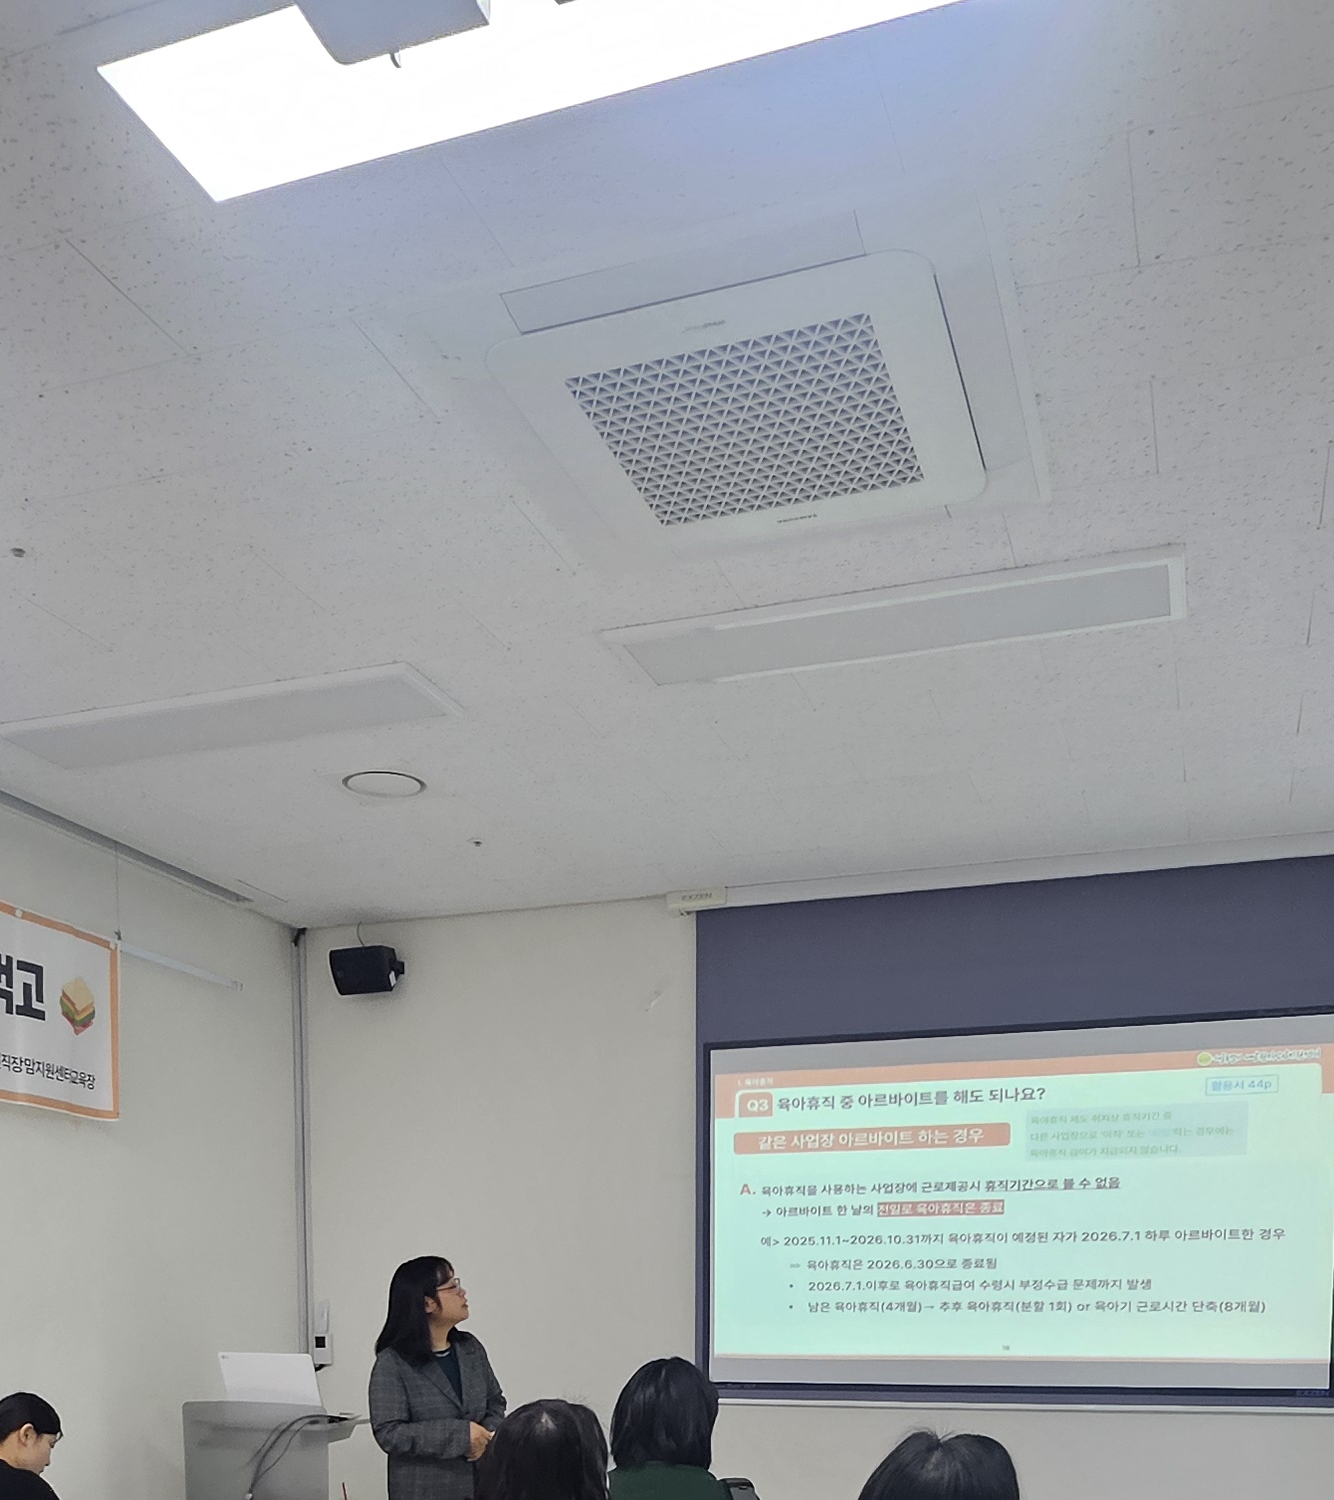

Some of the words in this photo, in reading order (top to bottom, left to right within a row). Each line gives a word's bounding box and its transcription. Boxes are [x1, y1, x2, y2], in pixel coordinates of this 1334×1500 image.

[1248, 1080, 1272, 1091] 44p
[747, 1099, 769, 1113] Q3
[777, 1095, 836, 1112] 육아휴직
[840, 1095, 854, 1110] 중
[858, 1090, 949, 1109] 아르바이트를
[953, 1089, 984, 1105] 해도
[988, 1087, 1046, 1104] 되나요?
[758, 1135, 787, 1151] 같은
[791, 1133, 835, 1150] 사업장
[838, 1130, 914, 1148] 아르바이트
[918, 1129, 949, 1145] 하는
[953, 1127, 984, 1144] 경우
[761, 1185, 818, 1197] 육아휴직을
[820, 1183, 868, 1196] 사용하는
[870, 1181, 918, 1195] 사업장에
[921, 1180, 981, 1194] 근로제공시
[985, 1178, 1059, 1193] 휴직기간으로
[1078, 1177, 1092, 1190] 수
[1095, 1176, 1121, 1190] 없음
[776, 1204, 833, 1218] 아르바이트
[837, 1204, 848, 1217] 한
[916, 1201, 977, 1215] 육아휴직은
[784, 1233, 944, 1247] 2025.11.1~2026.10.31까지
[948, 1232, 1008, 1245] 육아휴직이
[1012, 1231, 1049, 1244] 예정된
[1052, 1230, 1078, 1243] 자가
[1081, 1231, 1141, 1243] 2026.7.1
[1144, 1229, 1171, 1242] 하루
[1174, 1228, 1254, 1242] 아르바이트한
[1259, 1227, 1286, 1240] 경우
[807, 1259, 864, 1271] 육아휴직은
[867, 1259, 958, 1270] 2026.6.30으로
[904, 1279, 976, 1292] 육아휴직급여
[979, 1279, 1015, 1291] 수령시
[1019, 1278, 1069, 1291] 부정수급
[1072, 1278, 1122, 1291] 문제까지
[1126, 1278, 1152, 1290] 발생
[808, 1301, 831, 1313] 남은
[1077, 1303, 1091, 1312] or
[1094, 1300, 1132, 1313] 육아기
[1136, 1300, 1188, 1313] 근로시간
